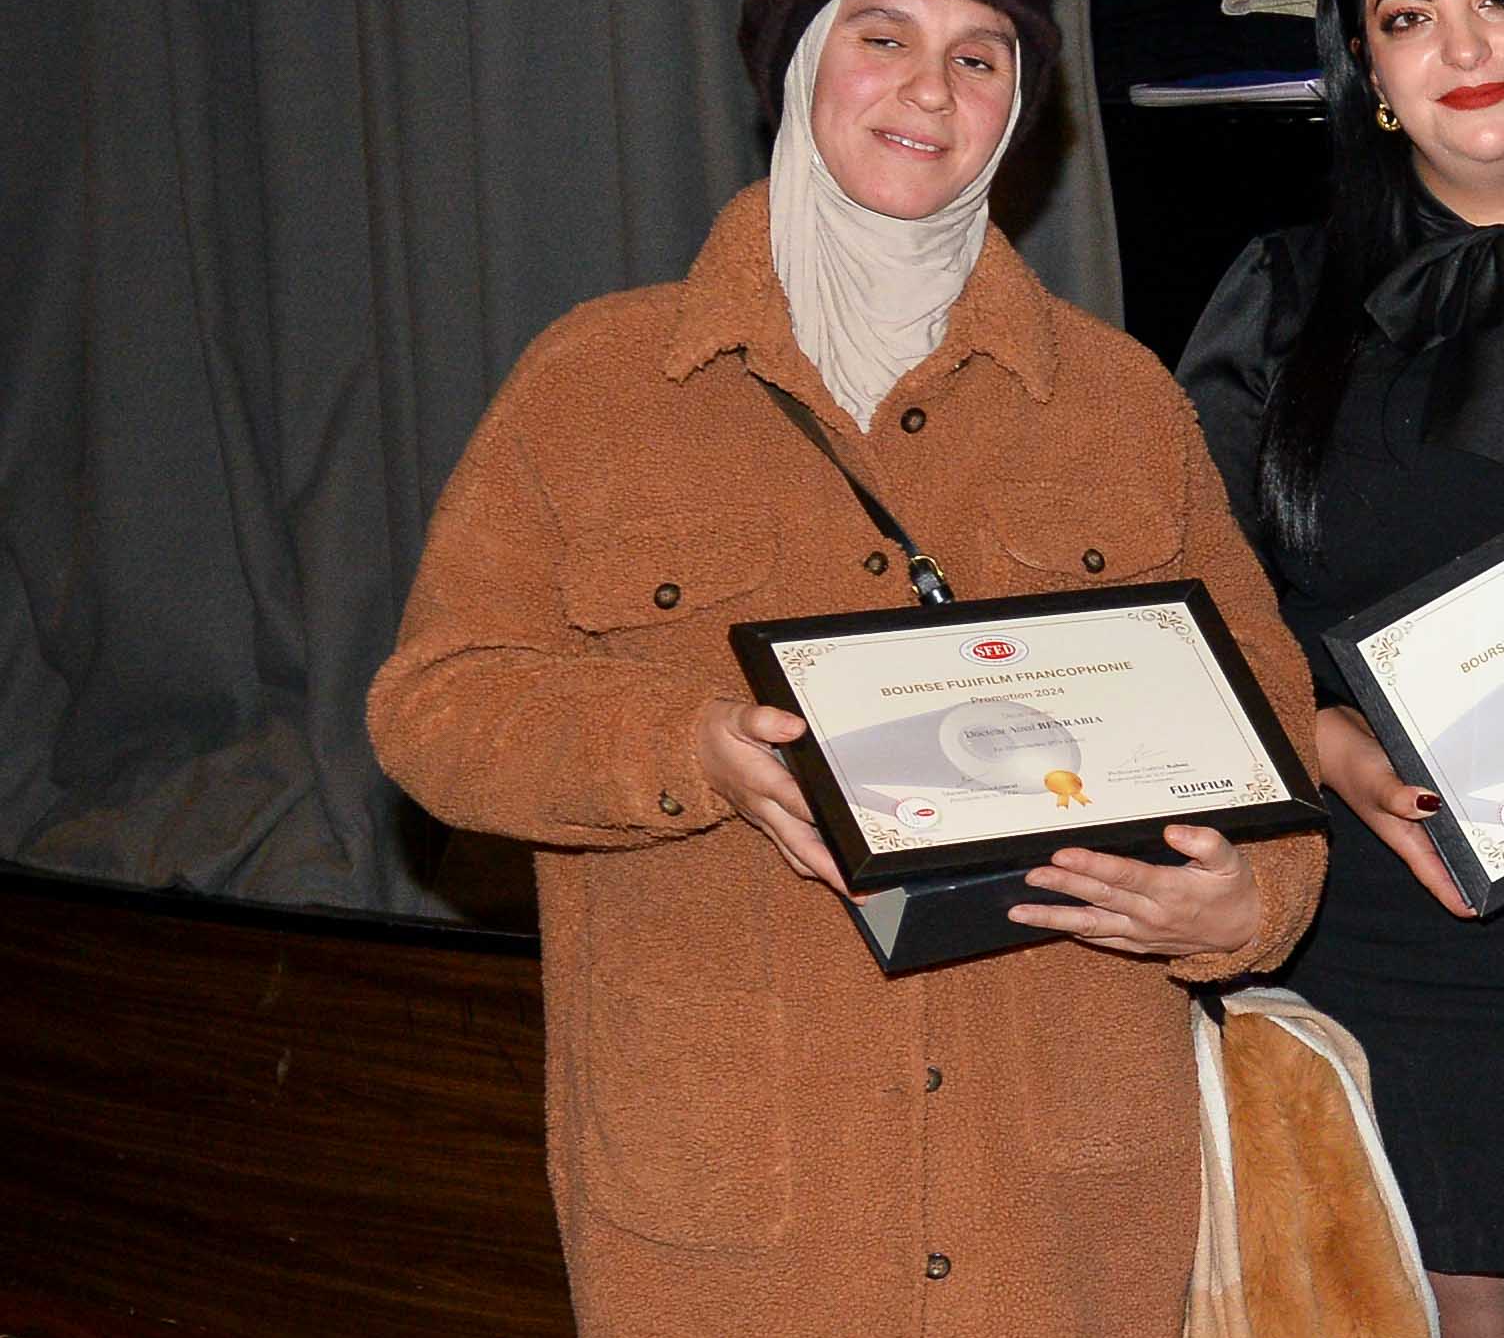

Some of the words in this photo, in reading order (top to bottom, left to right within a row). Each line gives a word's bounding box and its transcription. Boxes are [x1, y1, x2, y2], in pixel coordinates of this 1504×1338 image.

[974, 642, 1016, 658] SFED
[880, 681, 944, 697] BOURSE
[946, 674, 1013, 691] FUJIFILM
[1016, 660, 1134, 683] FRANCOPHONIE
[970, 690, 1033, 704] Promotion
[1035, 686, 1065, 699] 2024
[1169, 778, 1234, 796] FUJIFILM
